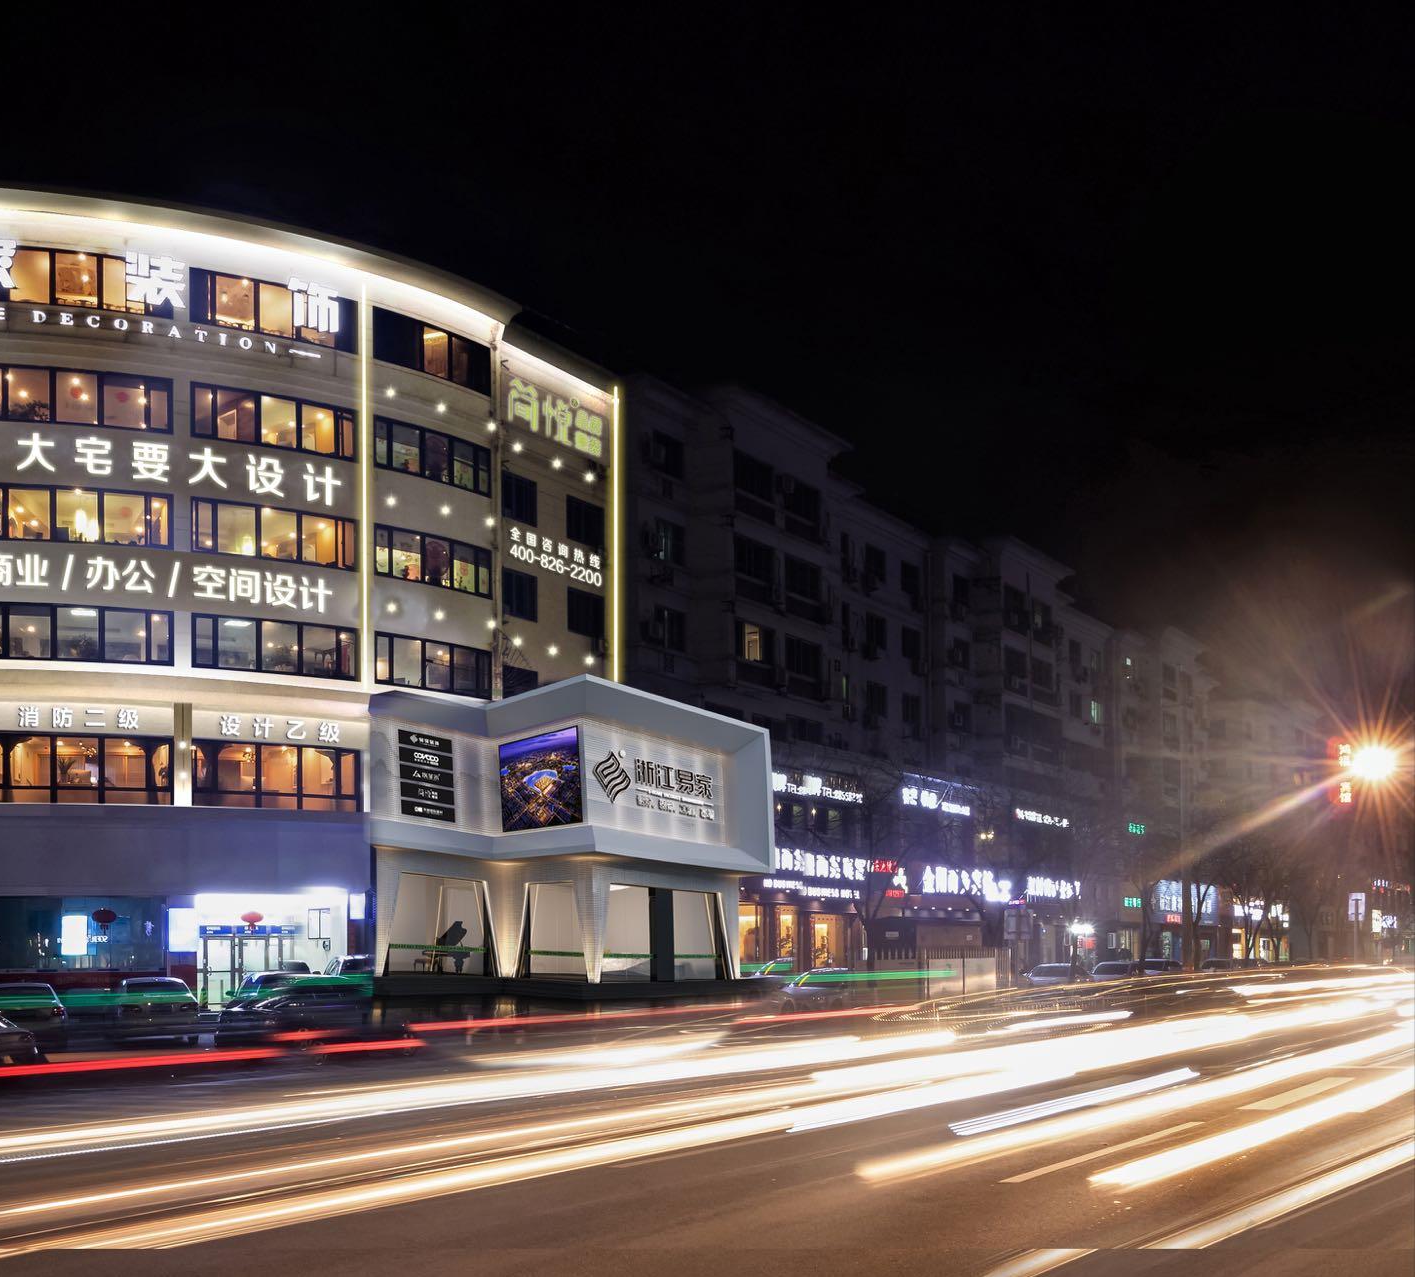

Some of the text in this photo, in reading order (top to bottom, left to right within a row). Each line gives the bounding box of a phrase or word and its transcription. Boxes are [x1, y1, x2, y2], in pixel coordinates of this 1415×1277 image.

[32, 310, 278, 355] DECORATION
[16, 432, 342, 506] 大宅要大设计
[509, 526, 601, 570] 全国咨询热线
[509, 544, 602, 587] 400-826-2200
[86, 556, 156, 593] 办公
[193, 565, 333, 613] 空间设计
[19, 706, 140, 731] 消防二级
[220, 714, 341, 743] 设计乙级
[634, 758, 714, 800] 浙江易家
